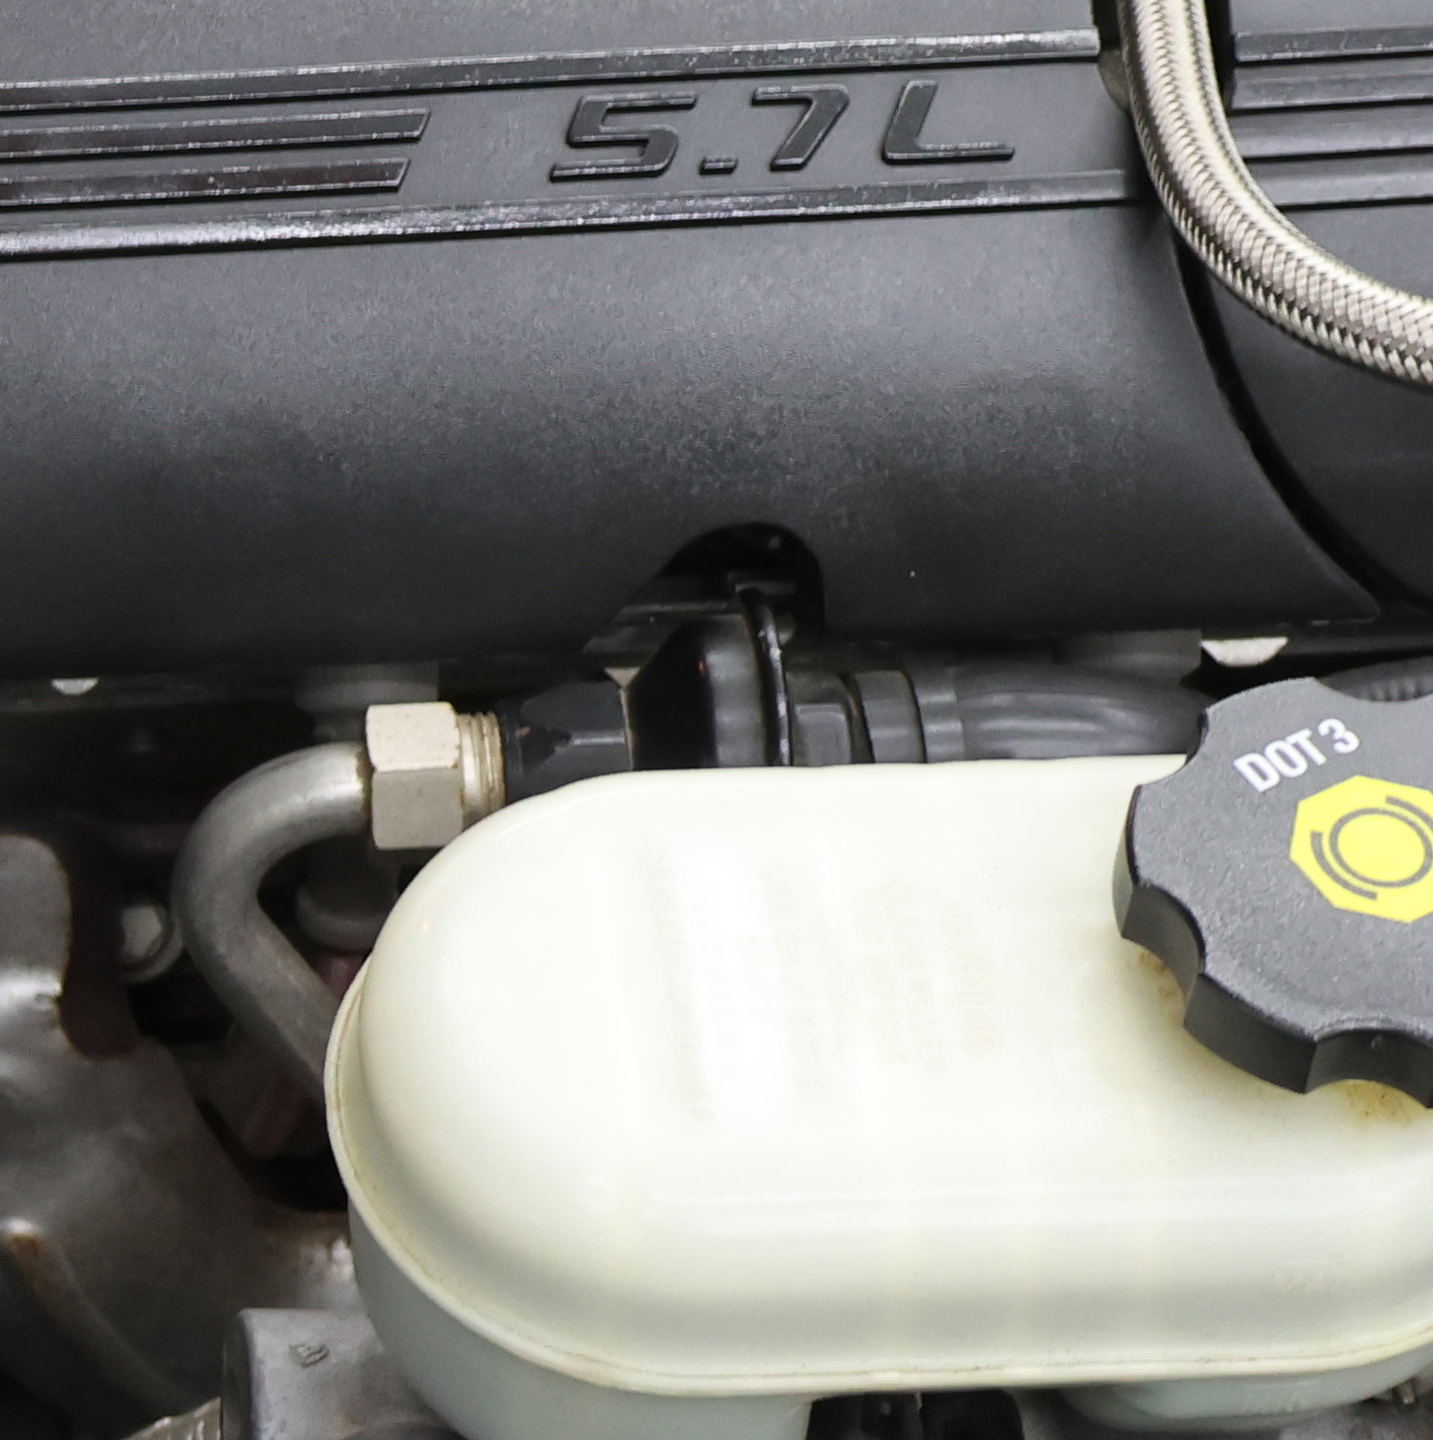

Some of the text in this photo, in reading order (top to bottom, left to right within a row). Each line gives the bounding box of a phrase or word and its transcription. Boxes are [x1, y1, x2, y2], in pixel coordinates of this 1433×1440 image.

[549, 79, 1016, 184] 5.7L
[1233, 717, 1360, 793] DOT 3
